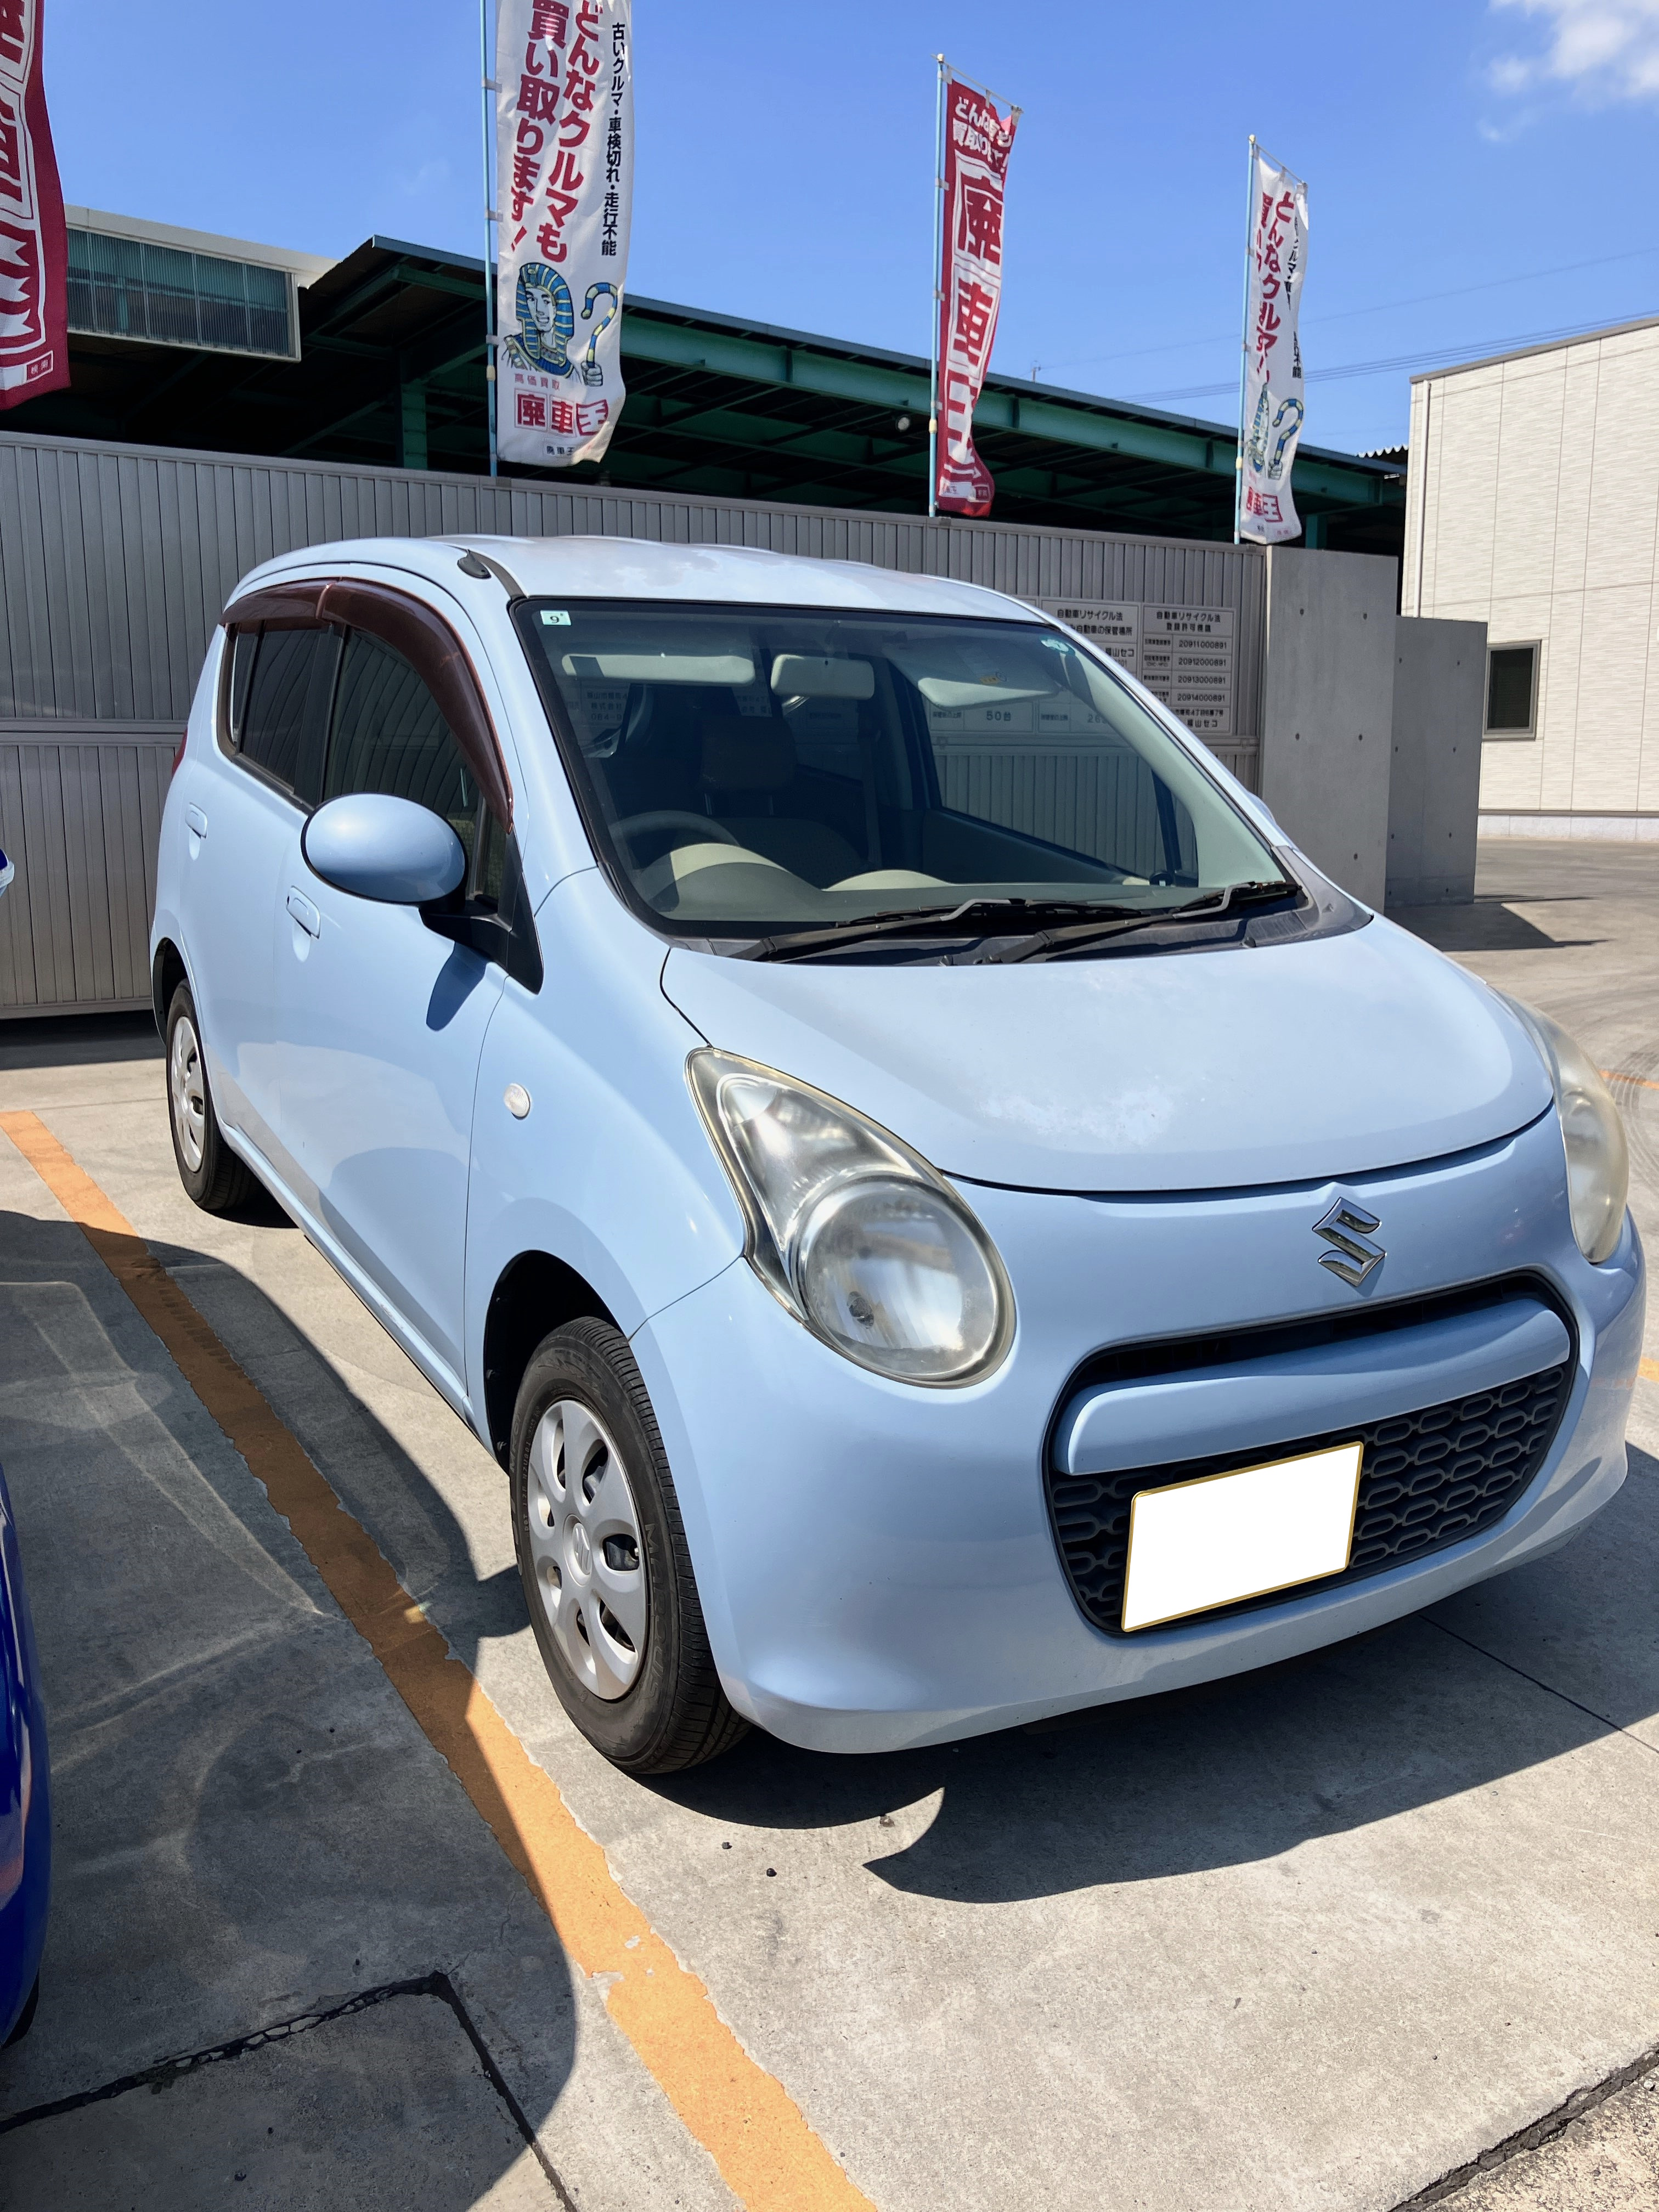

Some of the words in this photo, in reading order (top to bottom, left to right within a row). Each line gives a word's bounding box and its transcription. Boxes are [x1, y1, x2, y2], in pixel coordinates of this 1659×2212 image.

[536, 0, 603, 263] どんなクルマも
[601, 22, 625, 256] 古いクルマ・車検切れ・走行不能
[515, 391, 609, 437] 廃車王
[1057, 608, 1123, 621] 自動車リサイクル法
[1156, 611, 1220, 623] 自動車リサイクル法
[1178, 640, 1227, 650] 20911000891
[1178, 657, 1226, 667] 20912000891
[1177, 675, 1226, 685] 20913000891
[1177, 692, 1225, 702] 20914000891
[986, 710, 1012, 723] 50台
